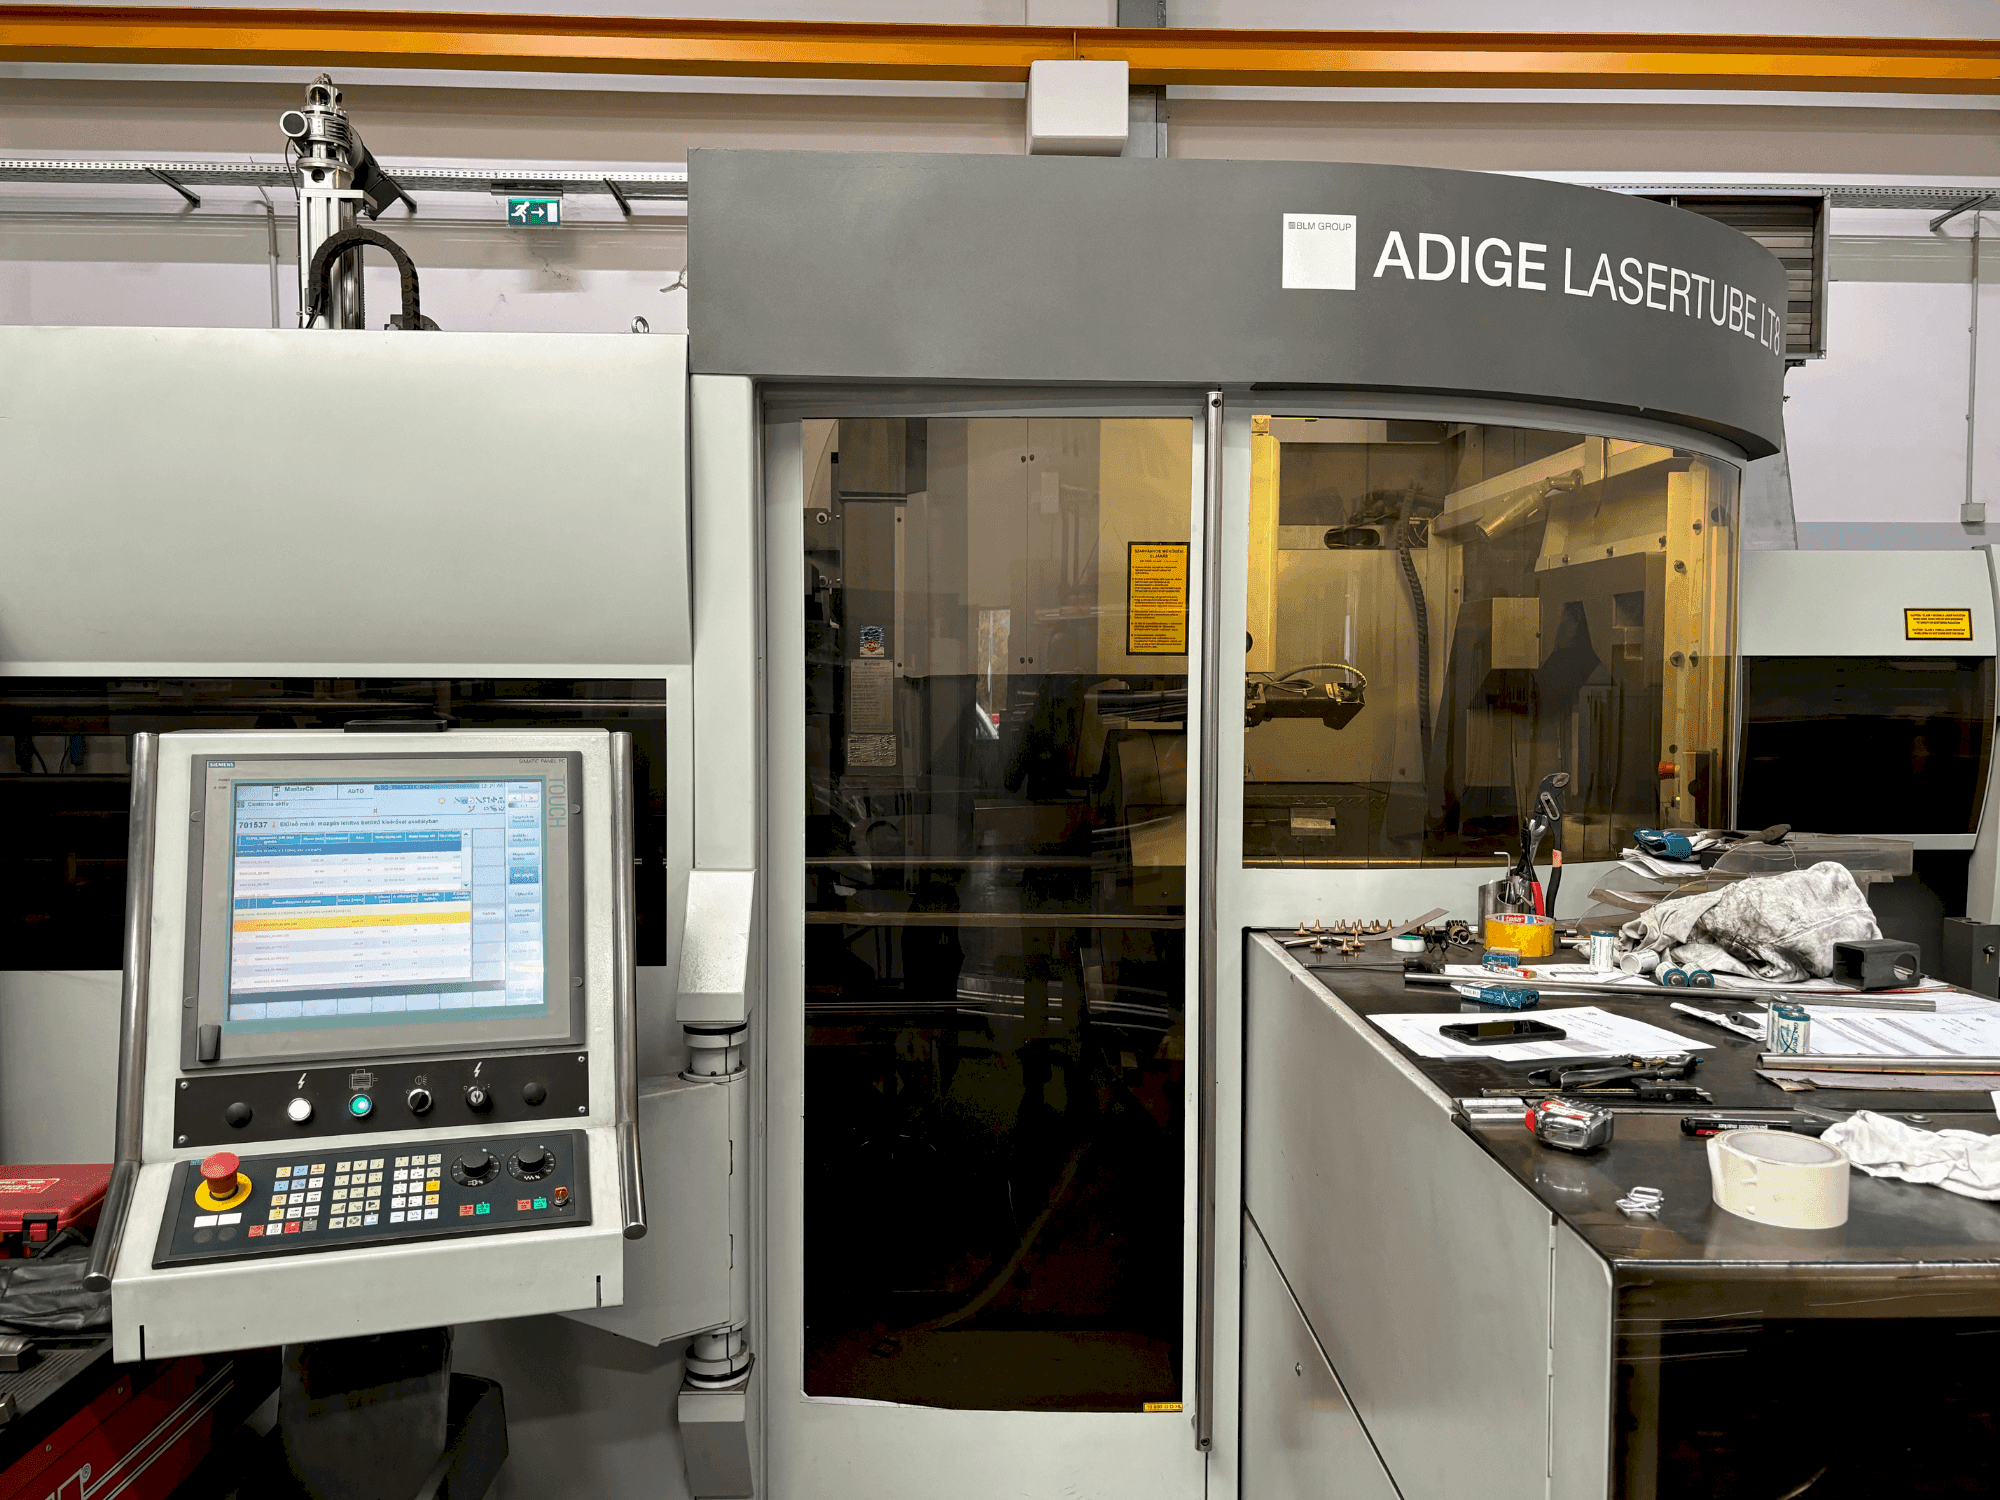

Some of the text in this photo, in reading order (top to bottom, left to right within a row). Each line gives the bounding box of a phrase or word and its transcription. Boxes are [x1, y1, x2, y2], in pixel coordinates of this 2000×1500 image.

[1297, 222, 1351, 231] BLM GROUP
[1373, 230, 1781, 356] ADIGE LASERTUBE LT8
[548, 774, 567, 828] TOUCH
